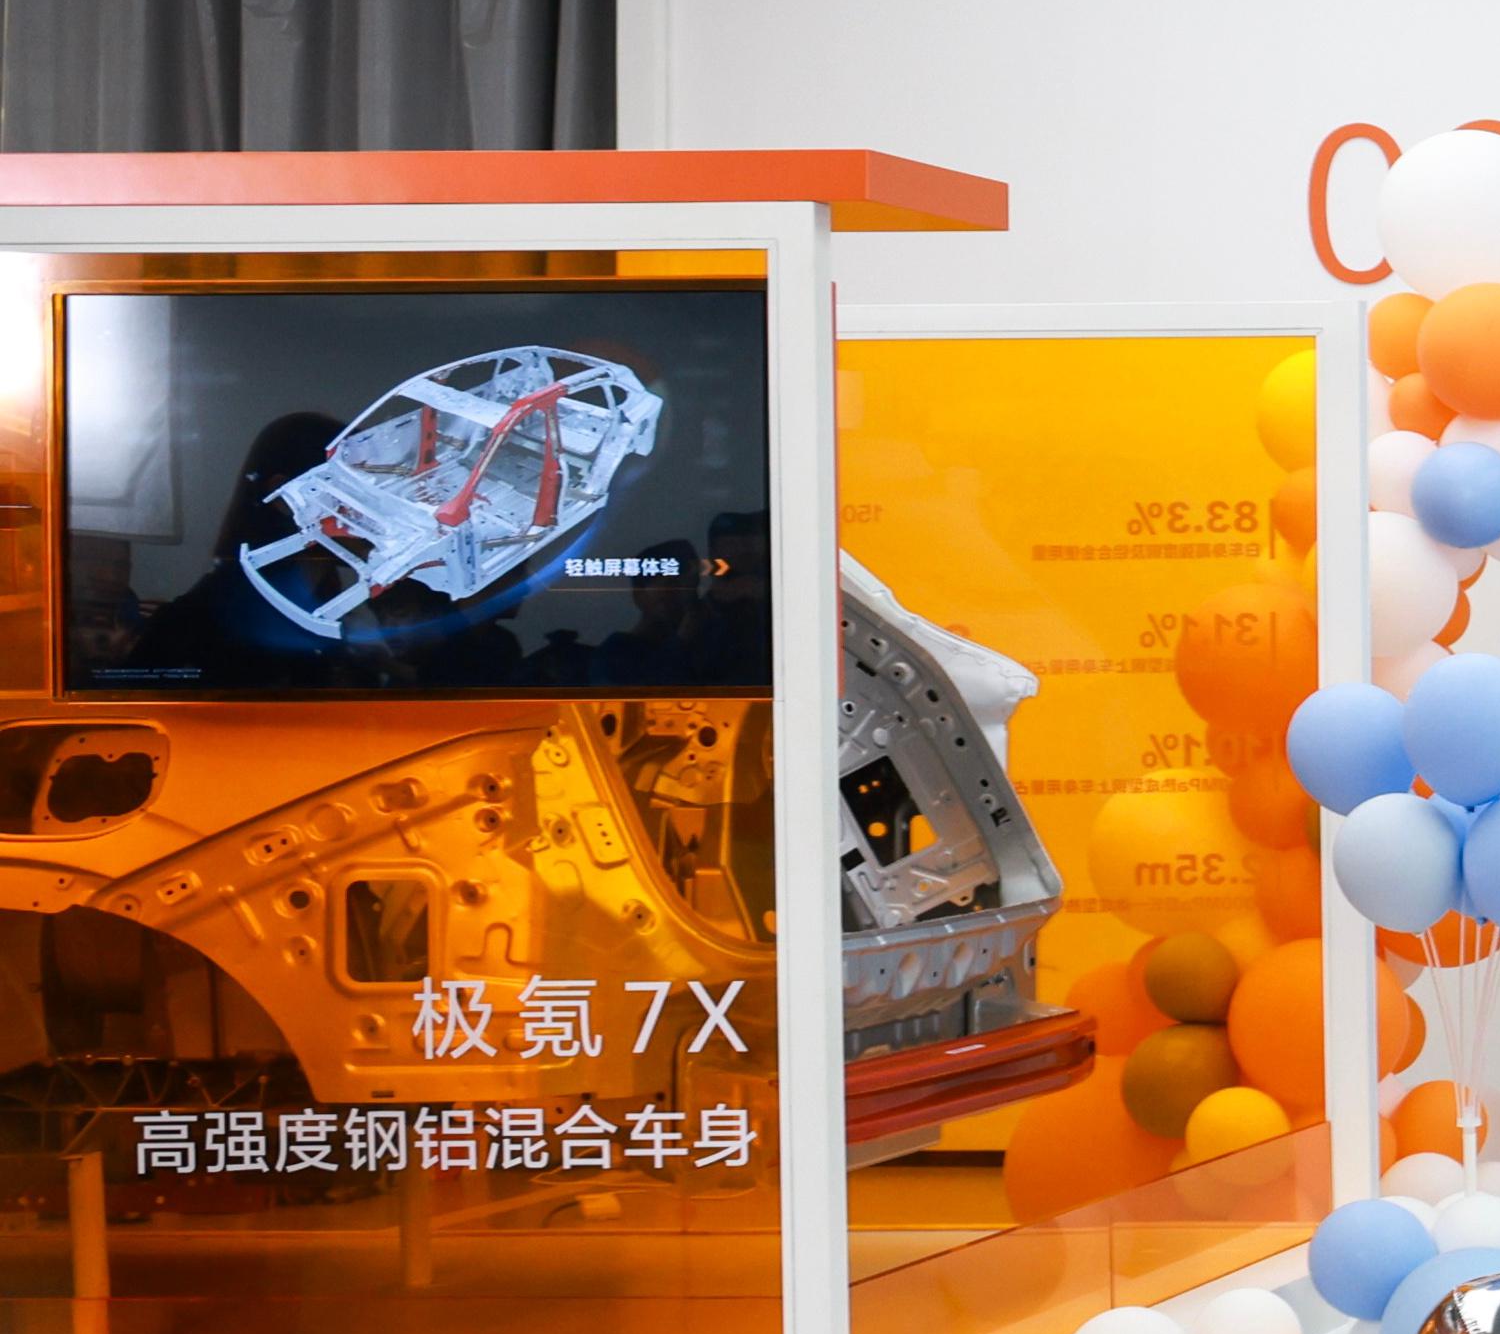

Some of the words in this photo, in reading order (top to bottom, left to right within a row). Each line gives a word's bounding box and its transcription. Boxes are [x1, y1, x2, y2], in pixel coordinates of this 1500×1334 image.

[411, 973, 749, 1061] 极氪7X
[132, 1102, 759, 1176] 高强度钢铝混合车身
